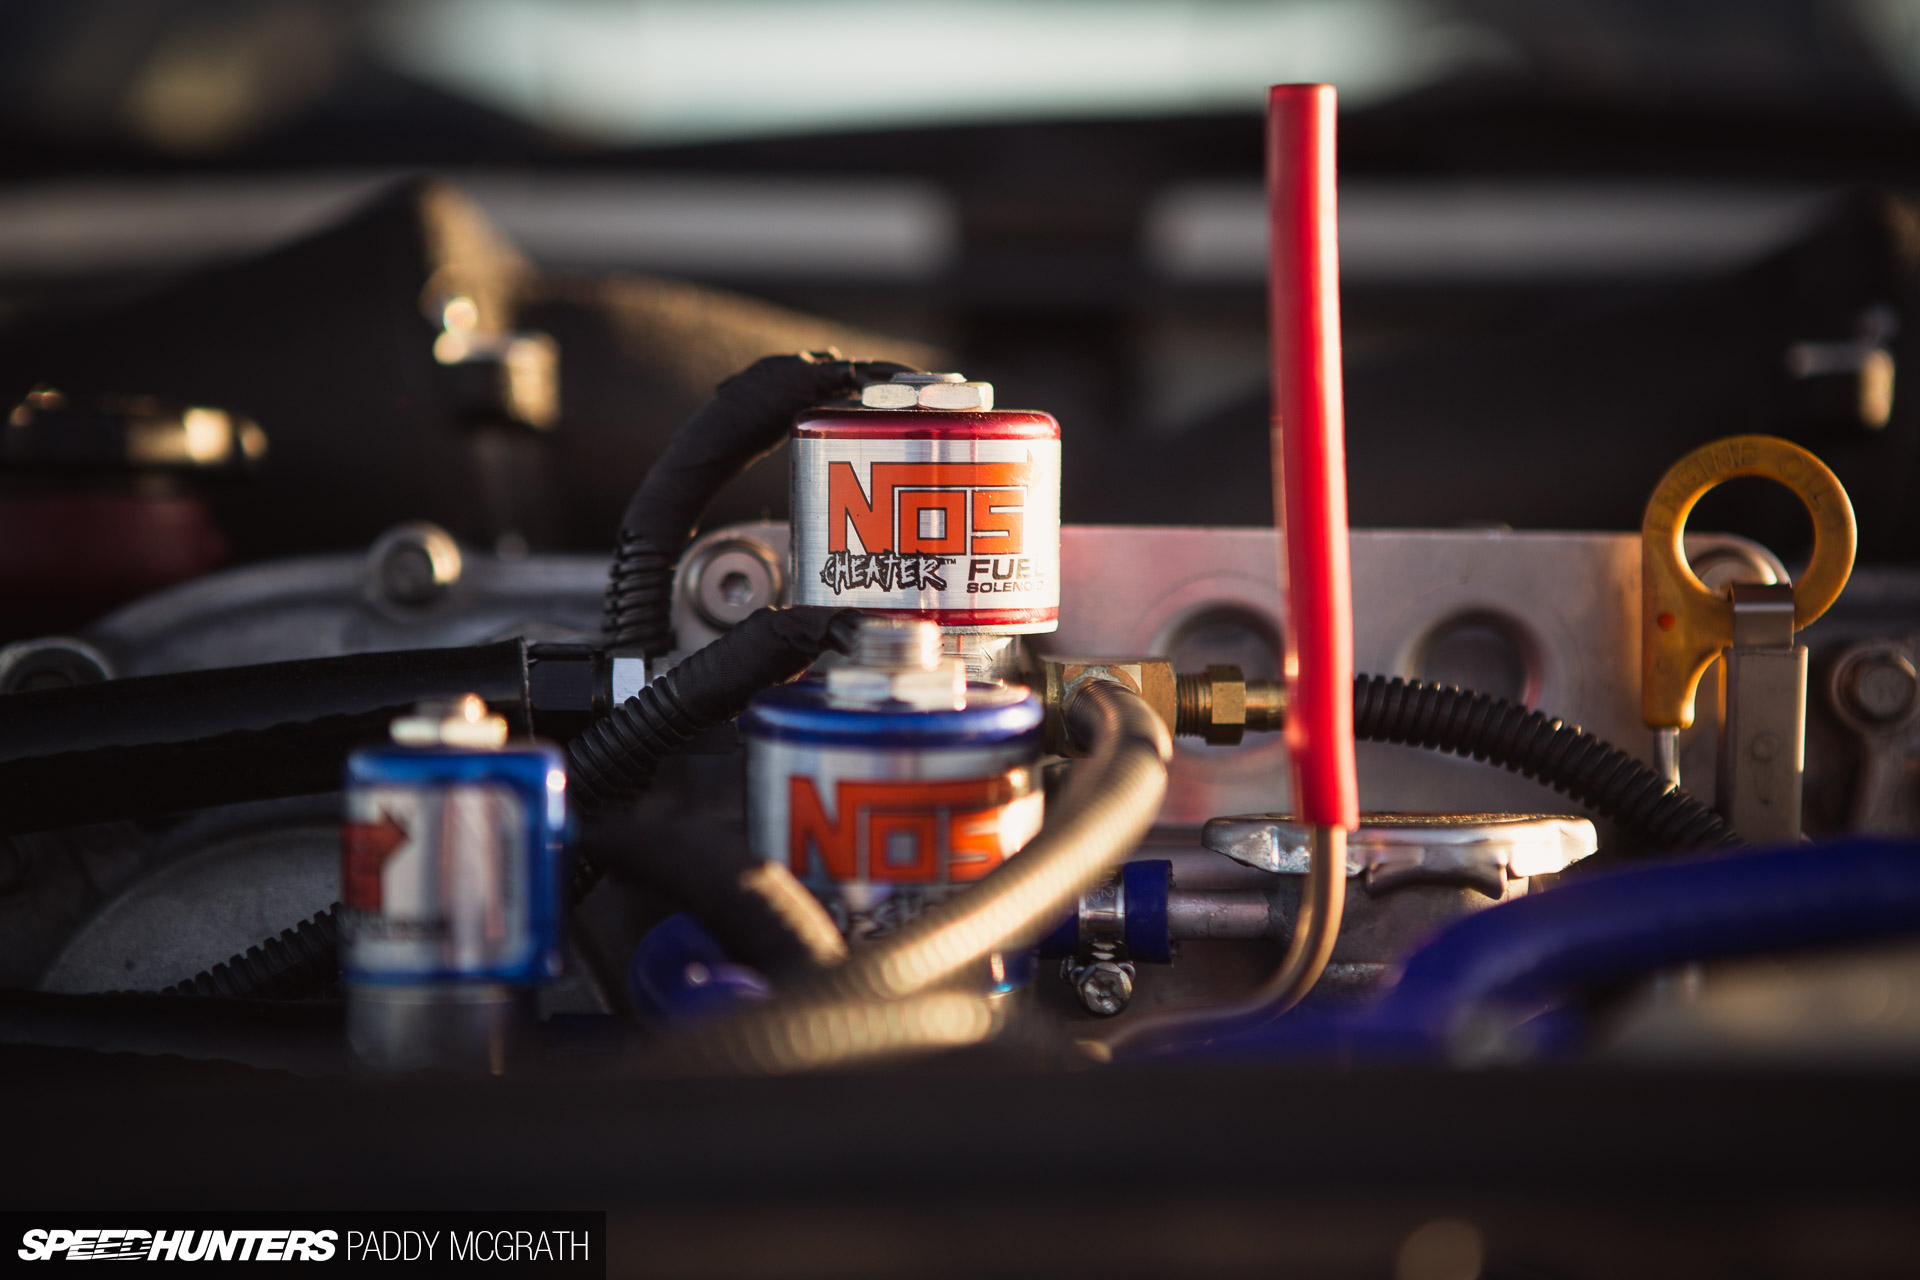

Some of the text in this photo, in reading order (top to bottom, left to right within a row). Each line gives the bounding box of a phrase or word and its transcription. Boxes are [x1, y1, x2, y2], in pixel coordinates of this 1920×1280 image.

[828, 460, 1036, 556] NOS
[1649, 443, 1835, 530] ENGINE OIL
[966, 581, 1045, 594] SOLENOD
[967, 558, 1045, 581] FUEL
[788, 775, 1006, 885] NOS
